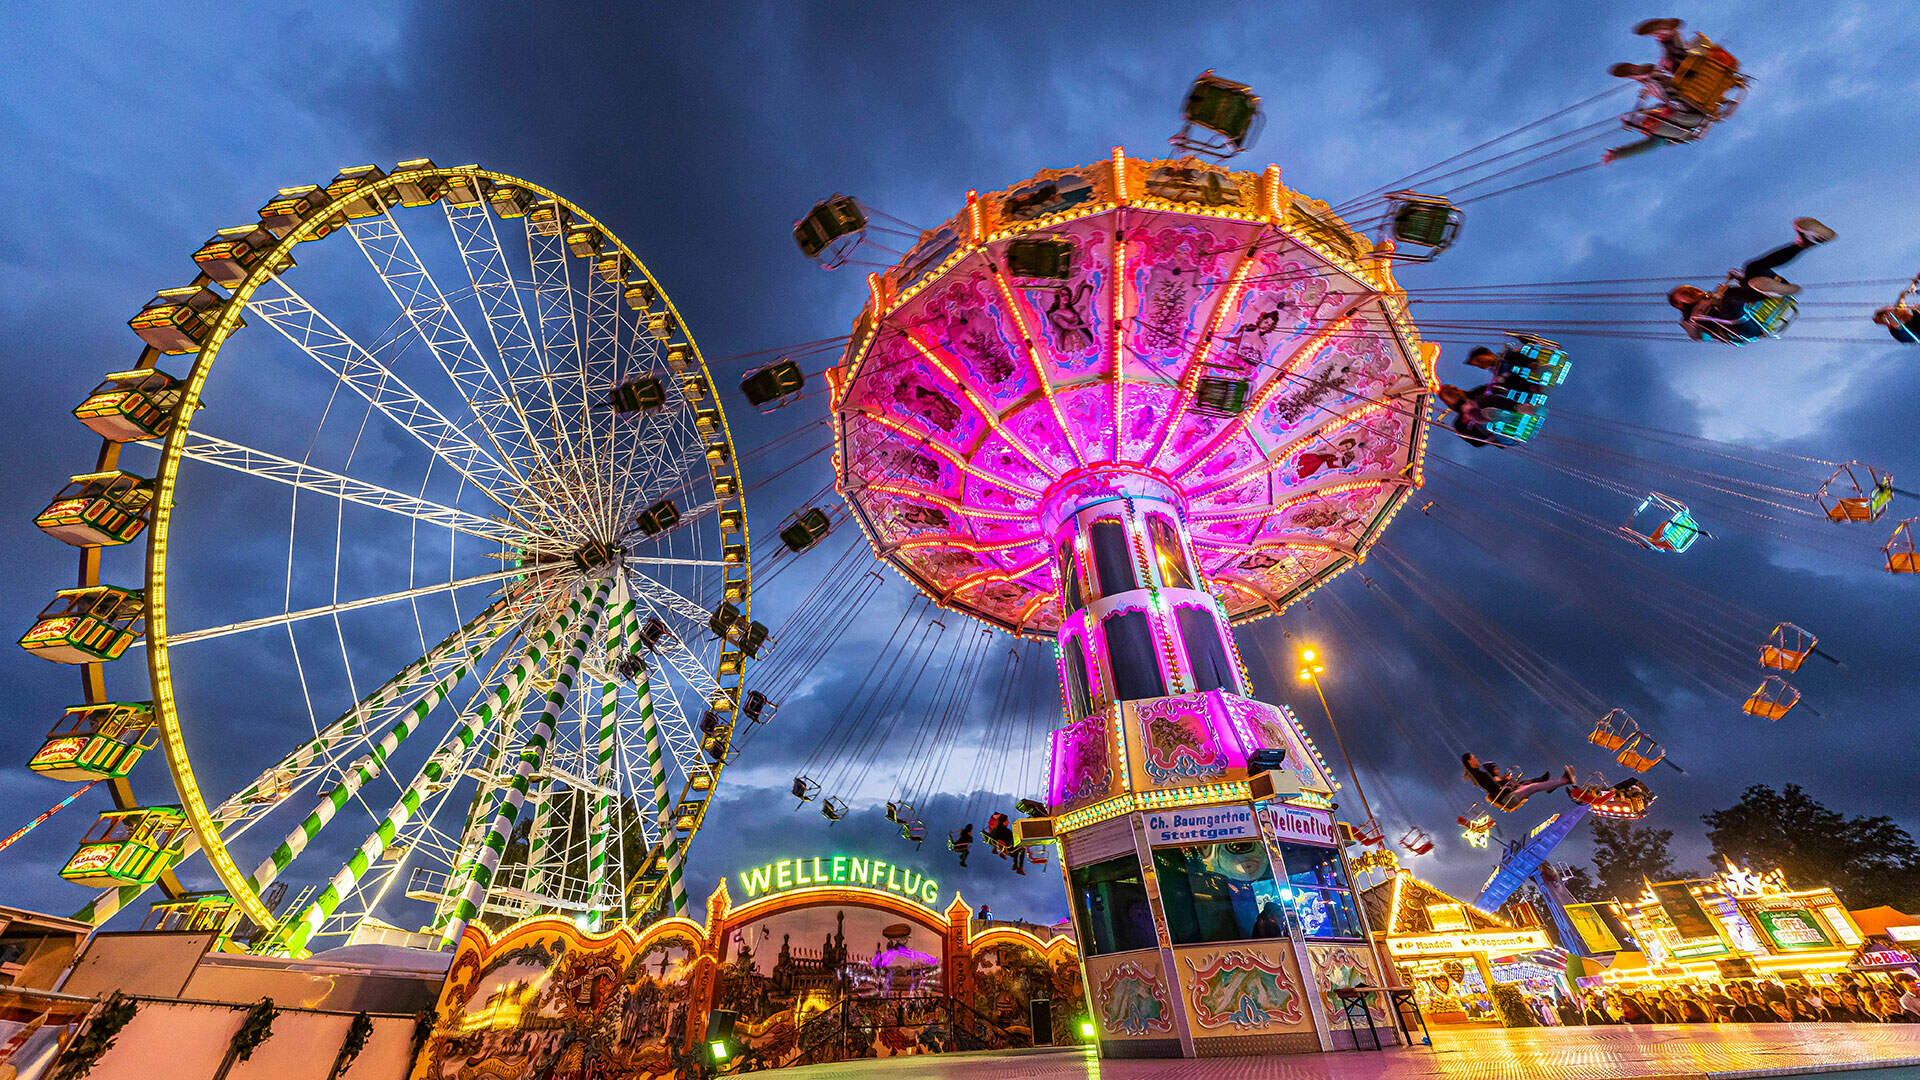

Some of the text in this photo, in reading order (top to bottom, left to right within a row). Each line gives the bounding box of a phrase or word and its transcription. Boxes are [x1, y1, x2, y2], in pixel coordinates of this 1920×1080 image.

[1149, 812, 1250, 830] Ch. Baumgartner
[1161, 825, 1246, 841] Stuttgart
[740, 856, 939, 904] WELLENFLUG
[1480, 937, 1517, 947] Popcorn
